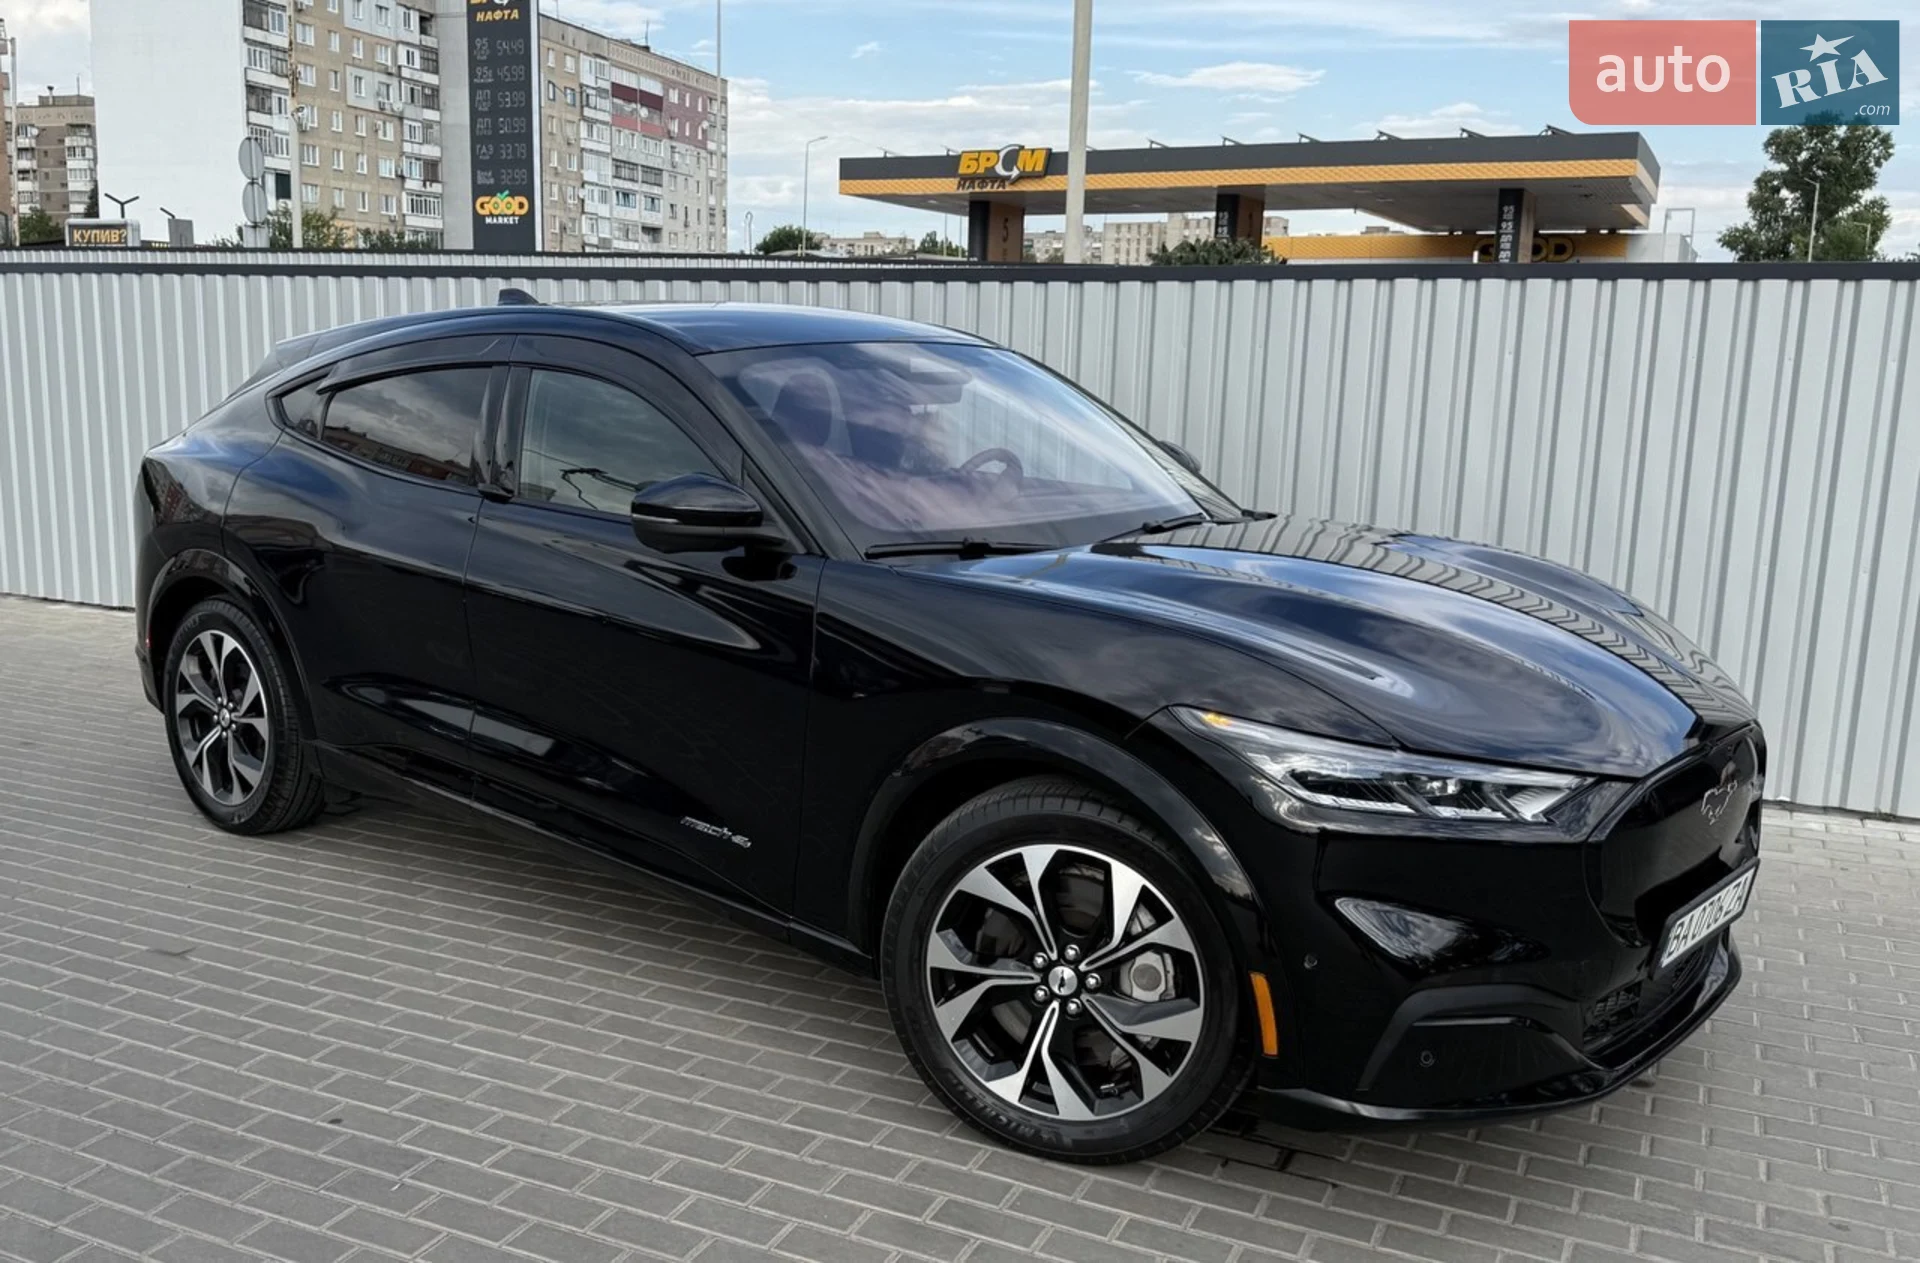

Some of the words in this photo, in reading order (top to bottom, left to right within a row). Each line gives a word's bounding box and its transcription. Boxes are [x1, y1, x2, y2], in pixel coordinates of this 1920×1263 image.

[476, 9, 520, 22] НАФТА
[957, 180, 1007, 190] НАФТА
[475, 195, 529, 216] GOOD
[485, 216, 520, 225] MARKET
[73, 229, 127, 243] КУПИВ?
[1666, 911, 1696, 958] BA
[1690, 888, 1729, 941] 0706
